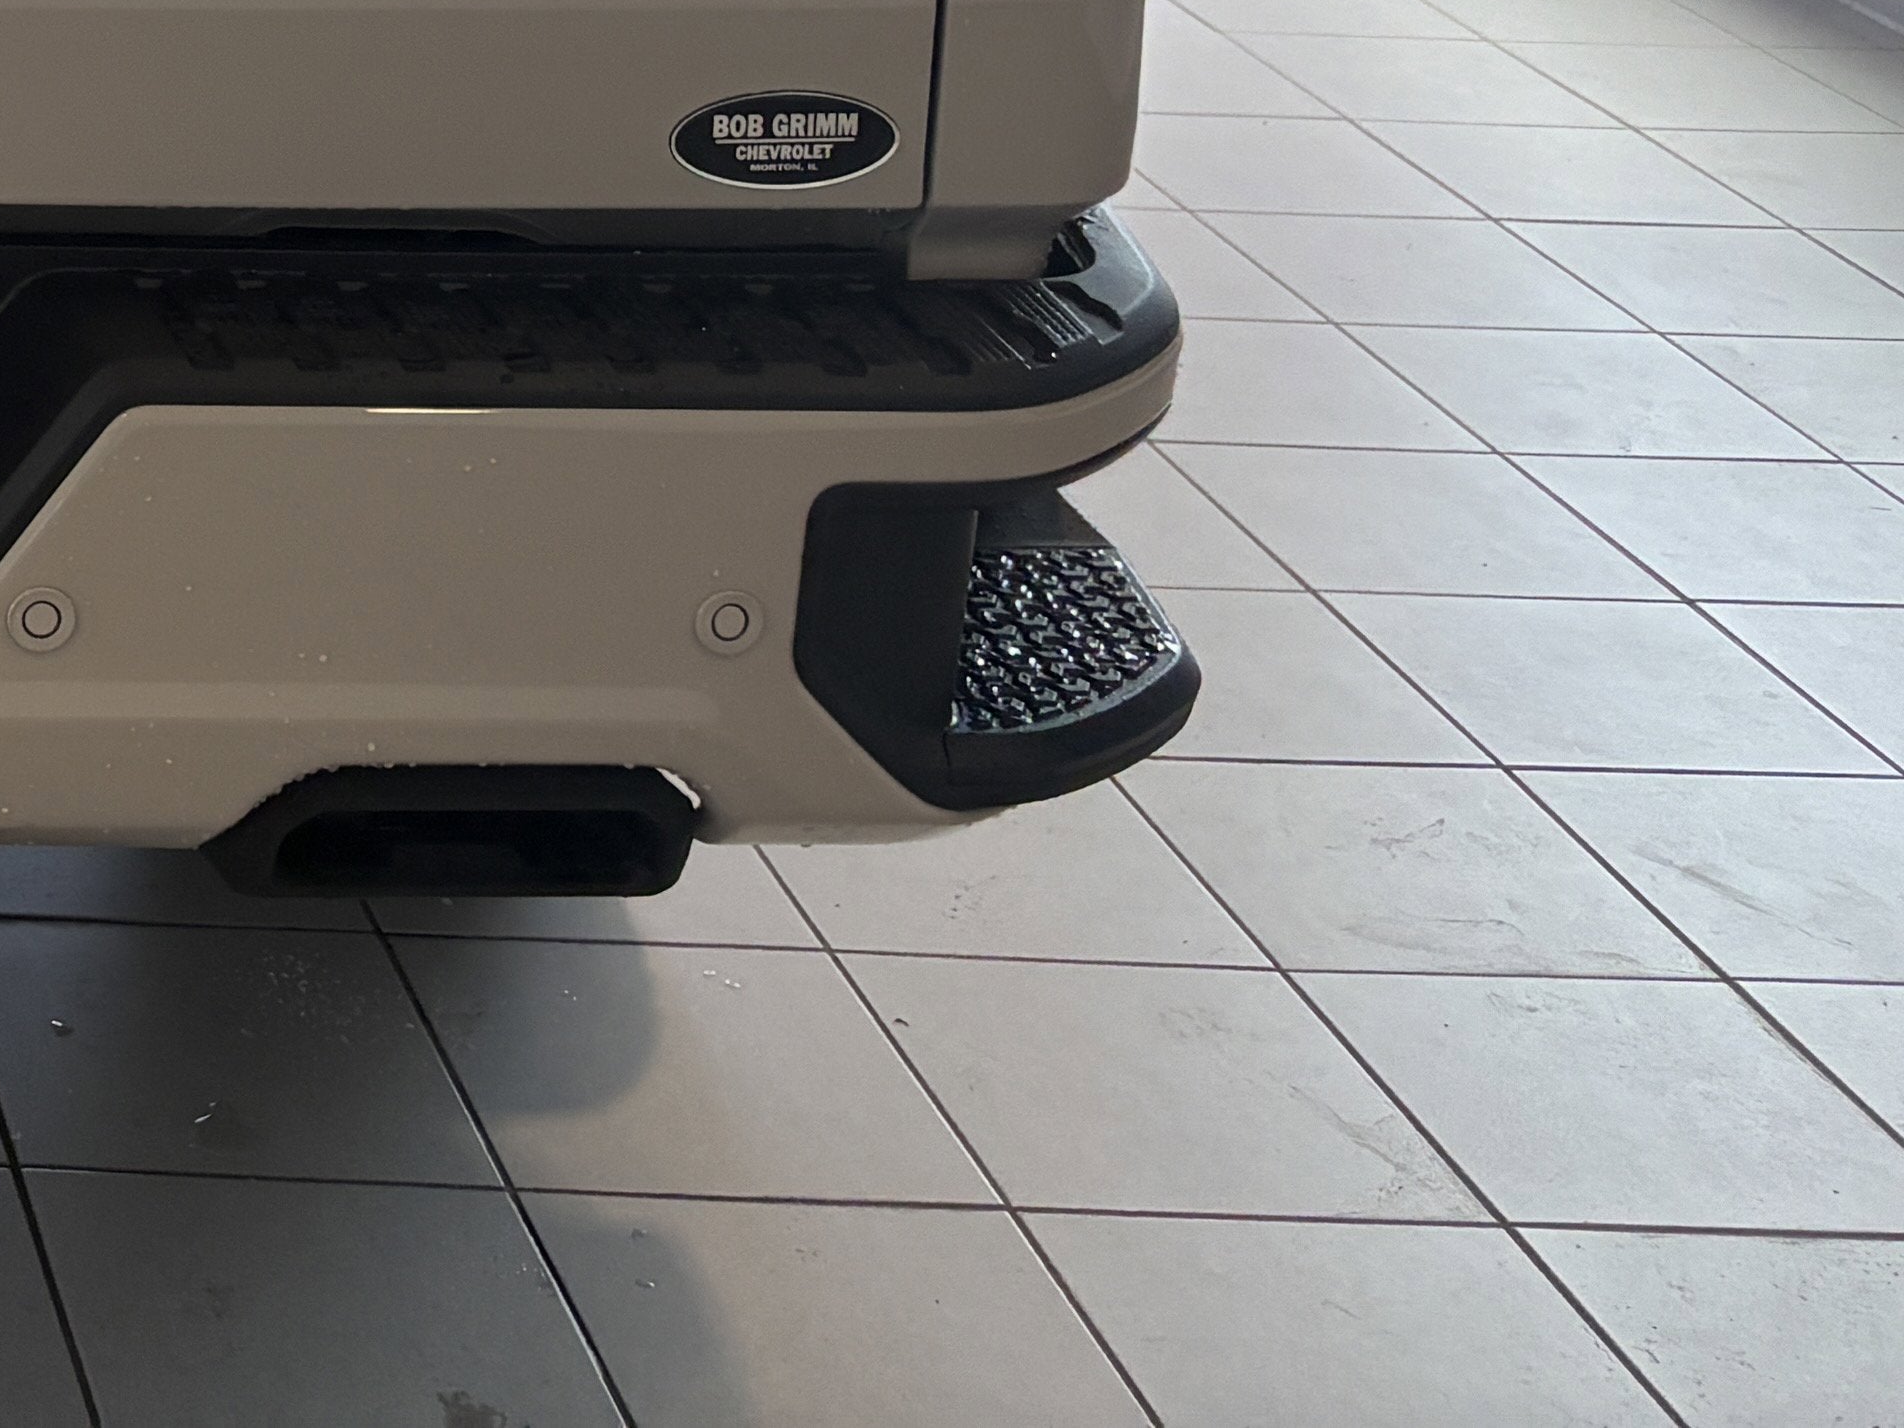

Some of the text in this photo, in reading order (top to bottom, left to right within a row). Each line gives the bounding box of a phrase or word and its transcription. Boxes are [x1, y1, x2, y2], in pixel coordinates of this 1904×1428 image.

[712, 112, 859, 139] BOB GRIMM
[735, 144, 834, 161] CHEVROLET
